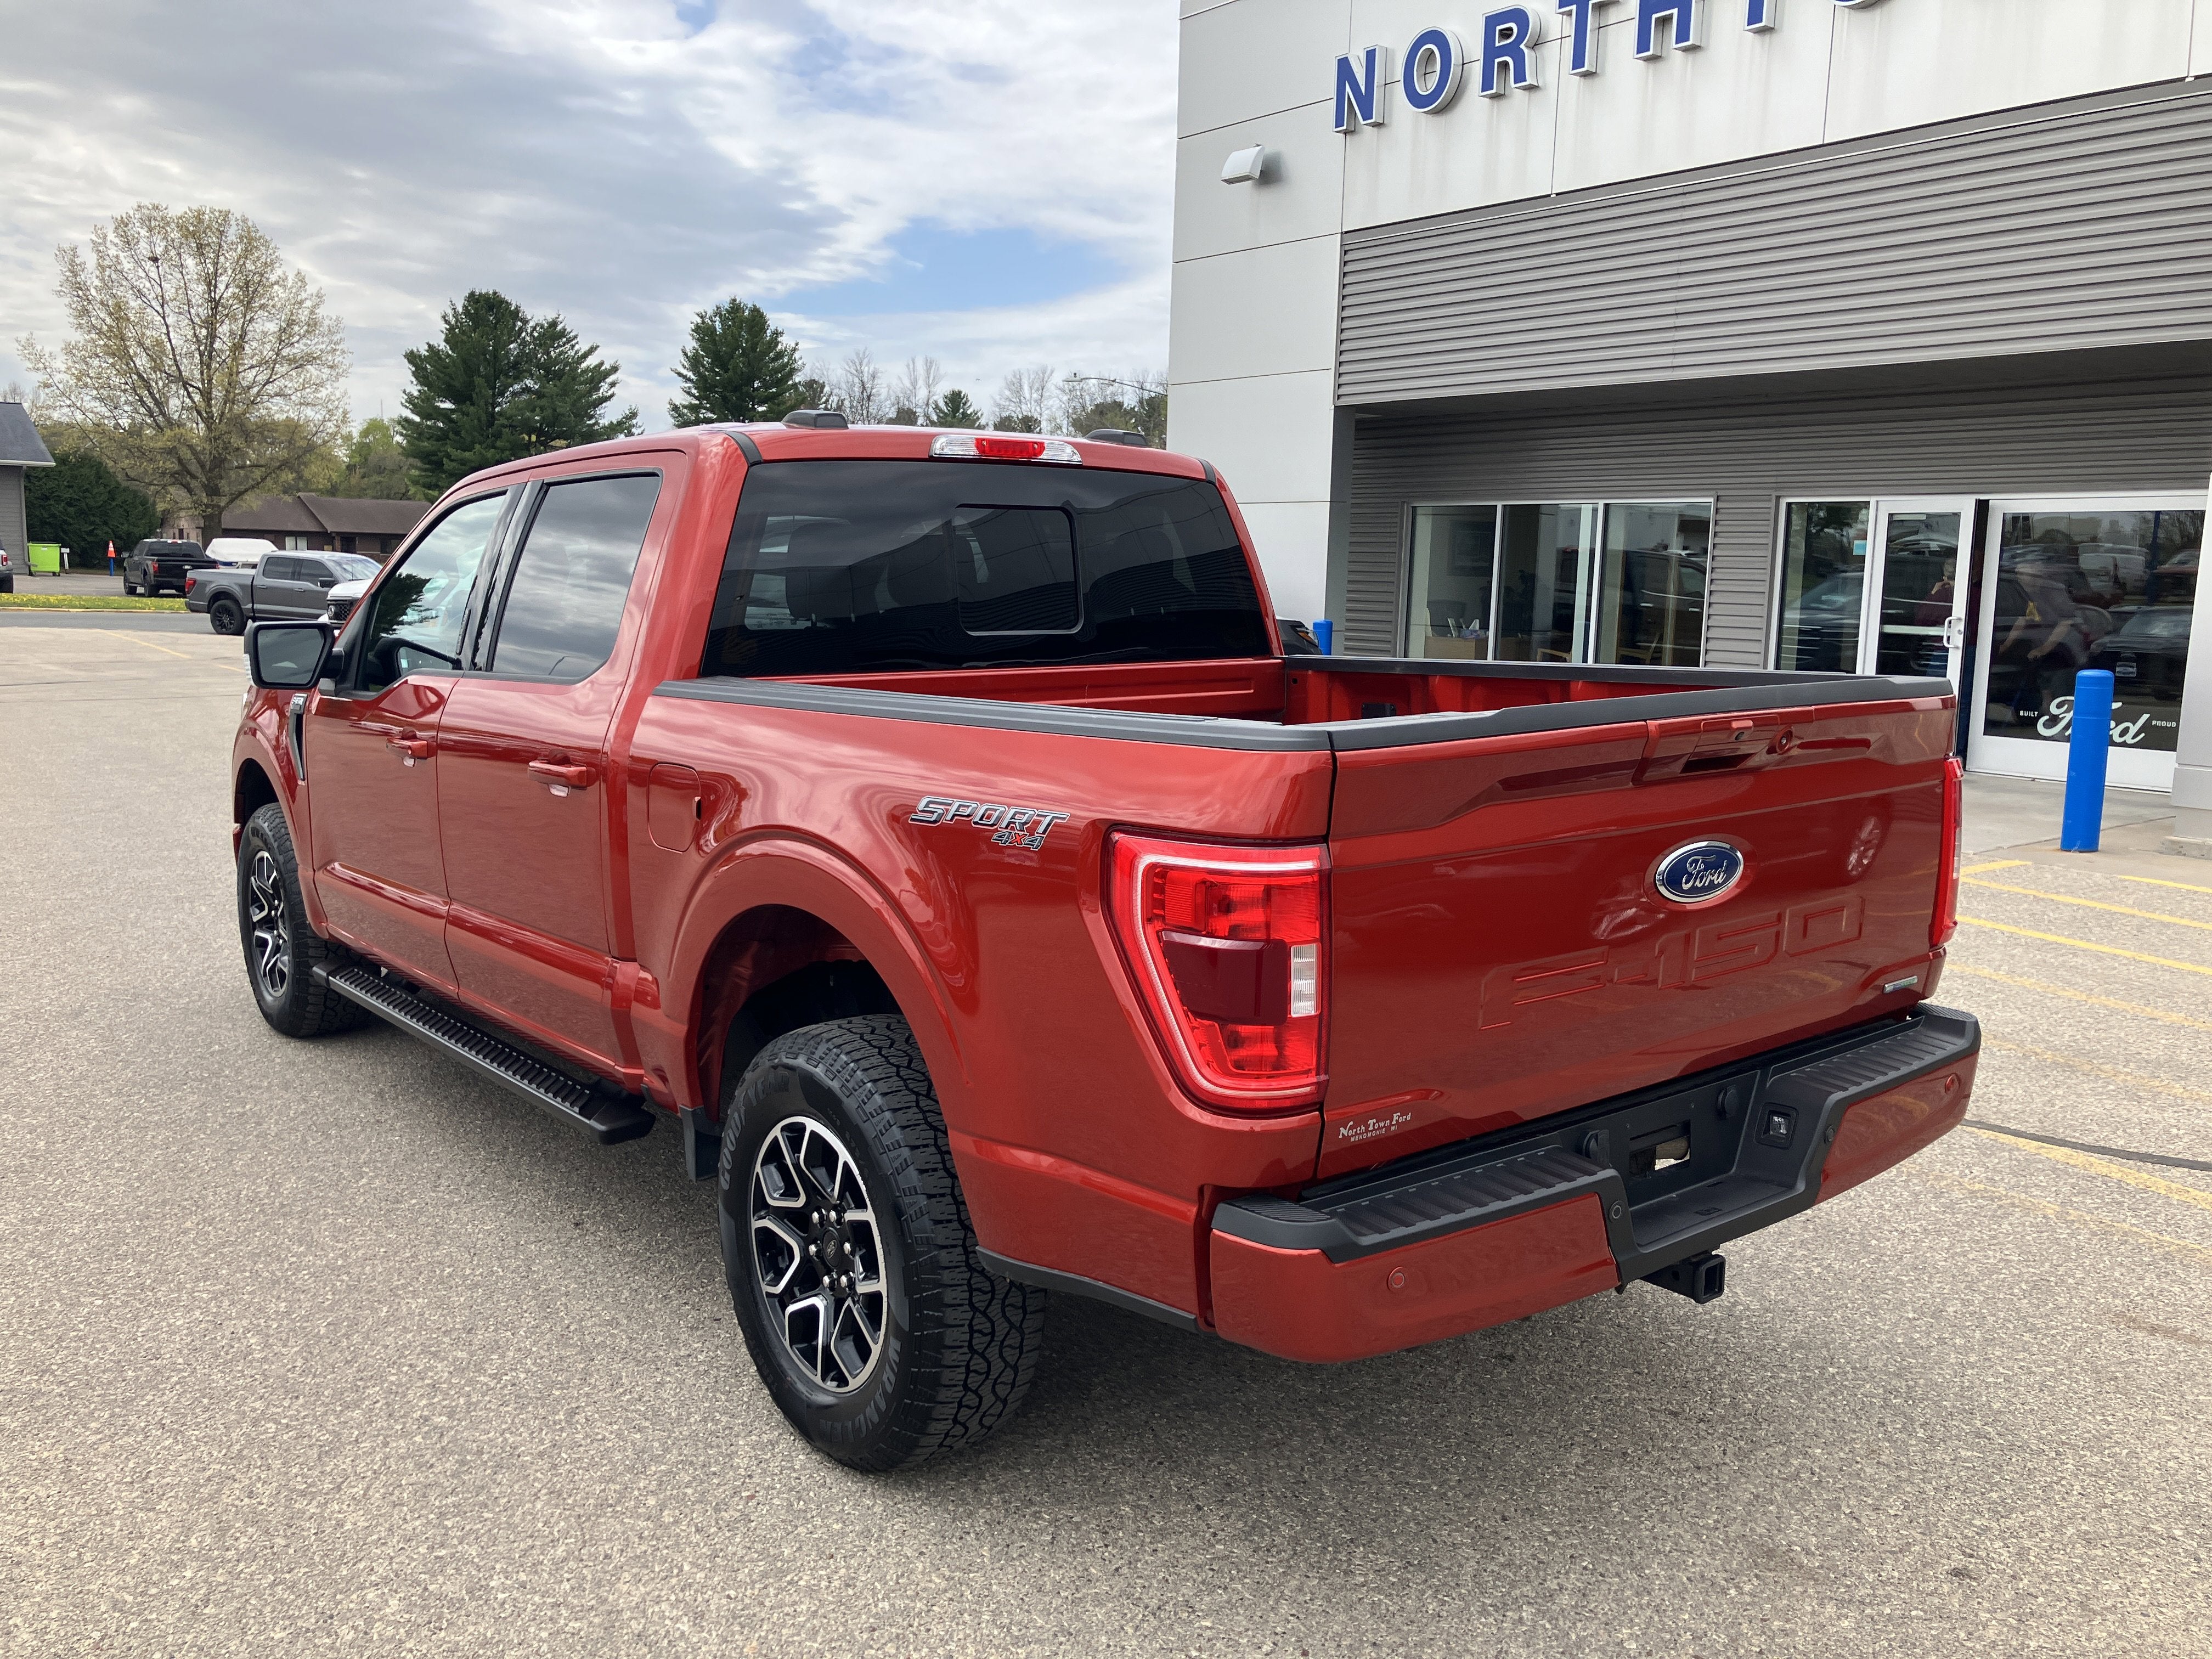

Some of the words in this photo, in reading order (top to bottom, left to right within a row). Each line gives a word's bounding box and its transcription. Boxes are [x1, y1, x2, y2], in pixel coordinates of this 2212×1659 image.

[1332, 0, 1882, 133] NORTH
[2036, 696, 2151, 744] Fd
[909, 795, 1070, 836] SPORT
[1681, 854, 1728, 890] Ford
[1479, 895, 1865, 1030] F-150
[1339, 1121, 1365, 1138] North
[1368, 1119, 1390, 1131] Town
[1391, 1112, 1412, 1124] Ford
[1351, 1128, 1386, 1142] MENOMONIE
